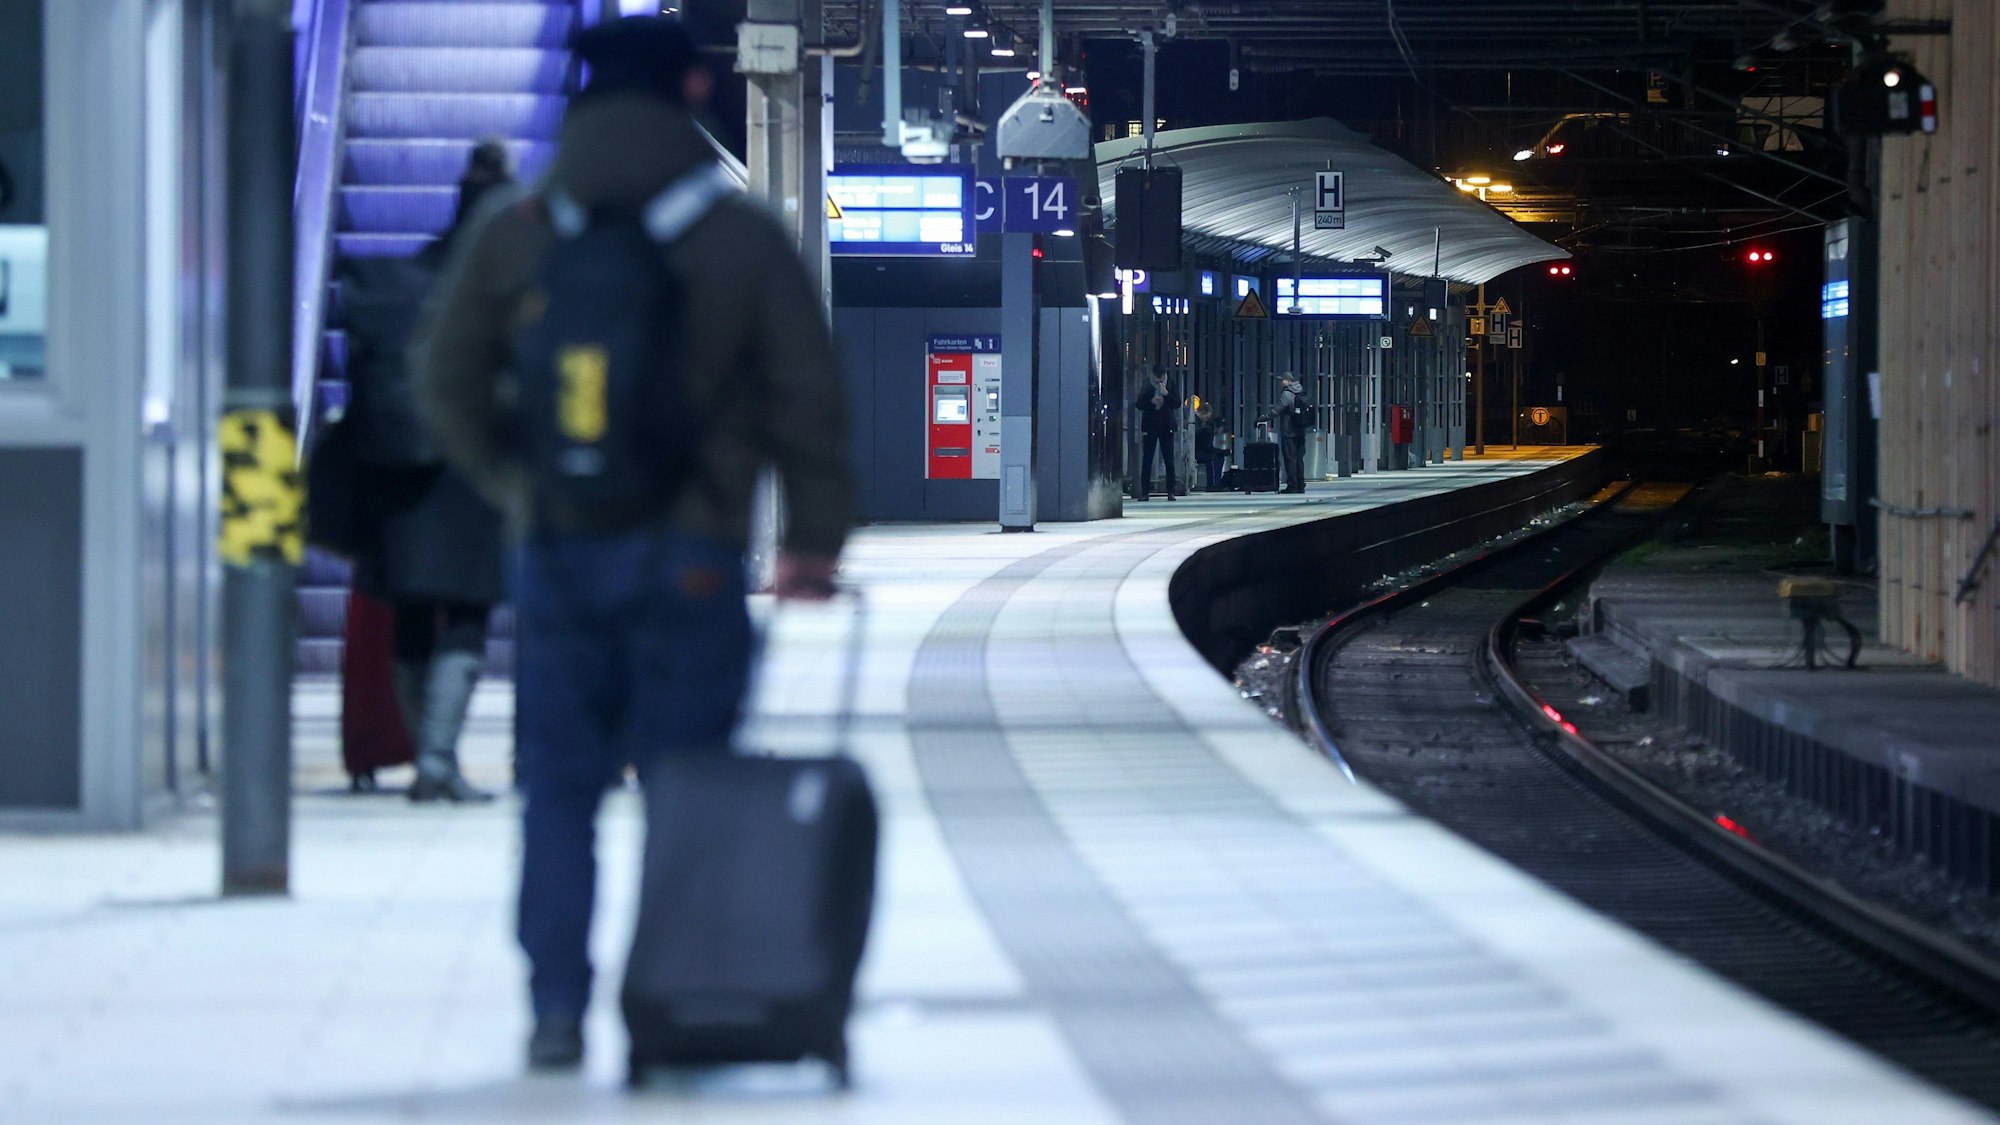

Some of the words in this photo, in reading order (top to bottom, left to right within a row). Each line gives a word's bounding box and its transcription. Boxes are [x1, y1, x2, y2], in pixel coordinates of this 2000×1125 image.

[975, 181, 995, 221] C
[1023, 181, 1069, 220] 14
[1319, 175, 1340, 208] H
[940, 243, 963, 253] Gleis
[964, 243, 974, 253] 14
[1492, 313, 1504, 332] H
[933, 338, 968, 346] Fahrkarten
[1510, 329, 1520, 346] H
